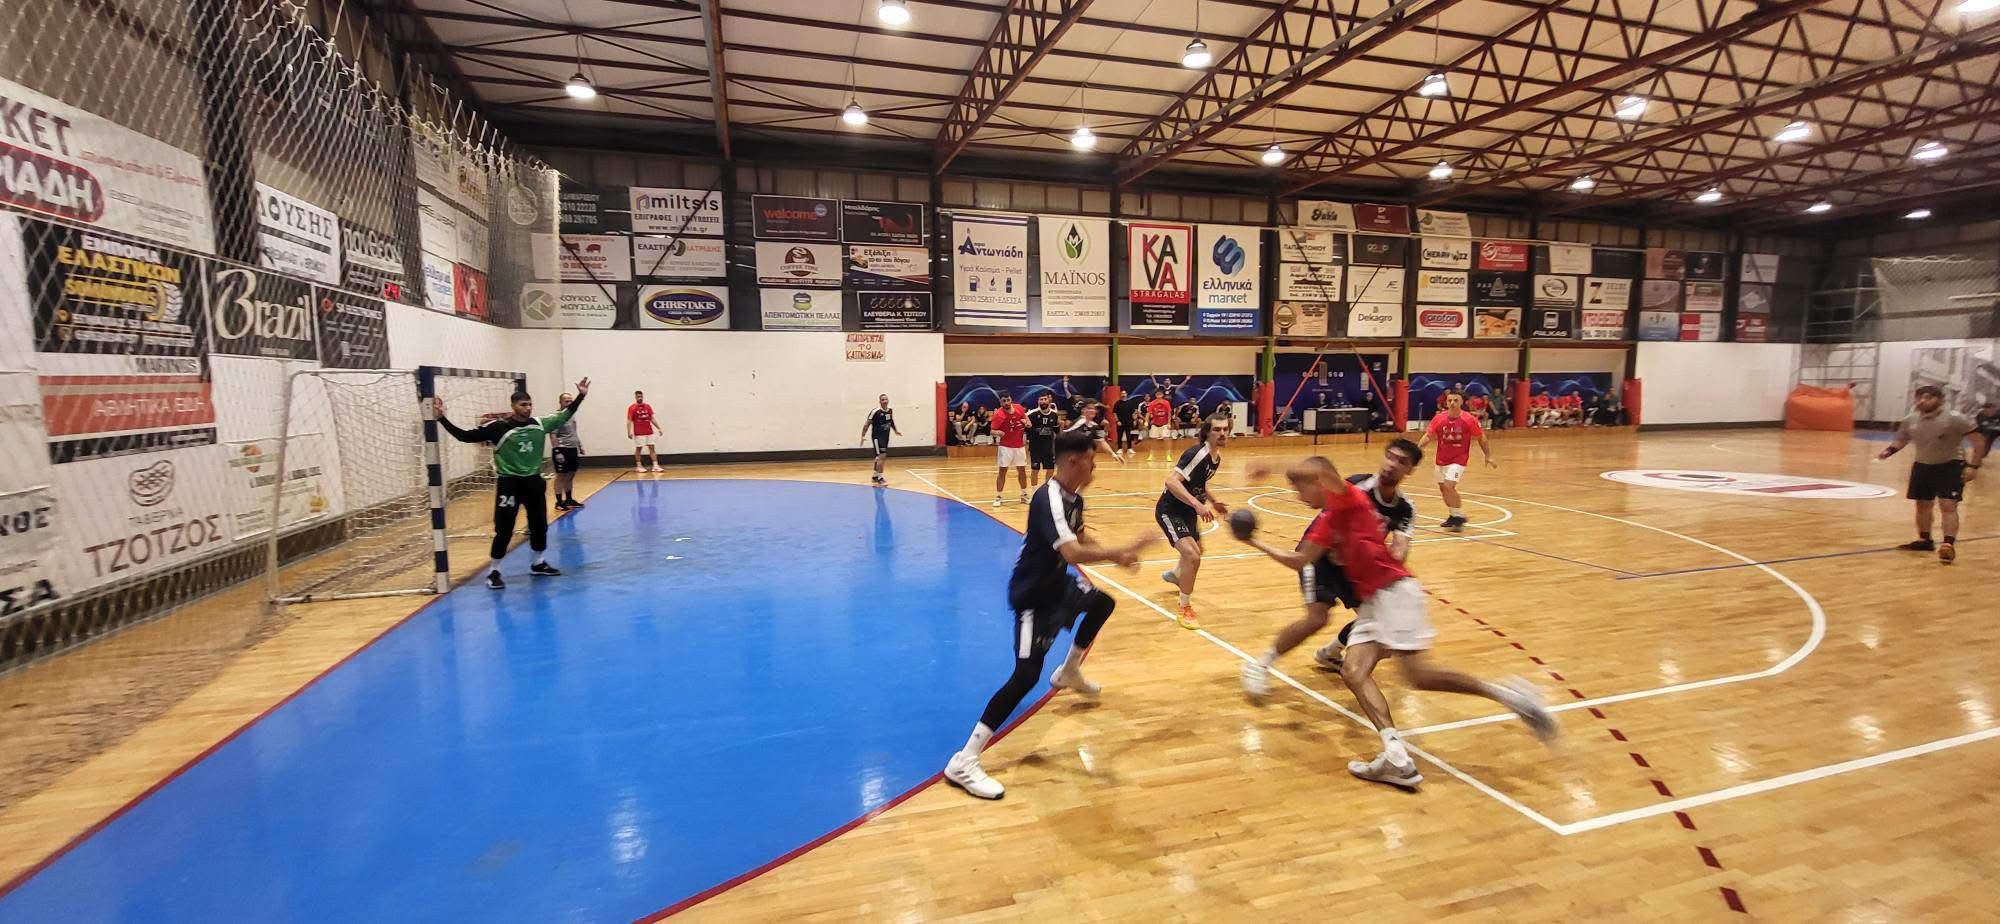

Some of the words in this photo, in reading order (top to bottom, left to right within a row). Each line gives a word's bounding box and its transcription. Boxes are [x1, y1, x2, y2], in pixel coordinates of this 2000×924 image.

[651, 194, 719, 211] miltsis
[763, 208, 818, 221] welcome
[58, 245, 182, 283] ΕΛΑΣΤΙΚΩΝ
[1202, 277, 1253, 293] ελληνικά
[1133, 290, 1185, 299] STRAGALAS
[1208, 292, 1248, 304] market
[215, 269, 312, 341] Brazil
[653, 300, 716, 310] CHRISTAKIS
[764, 311, 814, 319] ΑΠΕΝΤΟΜΩΤΙΚΗ
[816, 312, 841, 320] ΠΕΛΛΑΣ
[519, 441, 533, 453] 24
[498, 495, 515, 507] 24
[83, 514, 222, 578] ΤΖΟΤΖΟΣ
